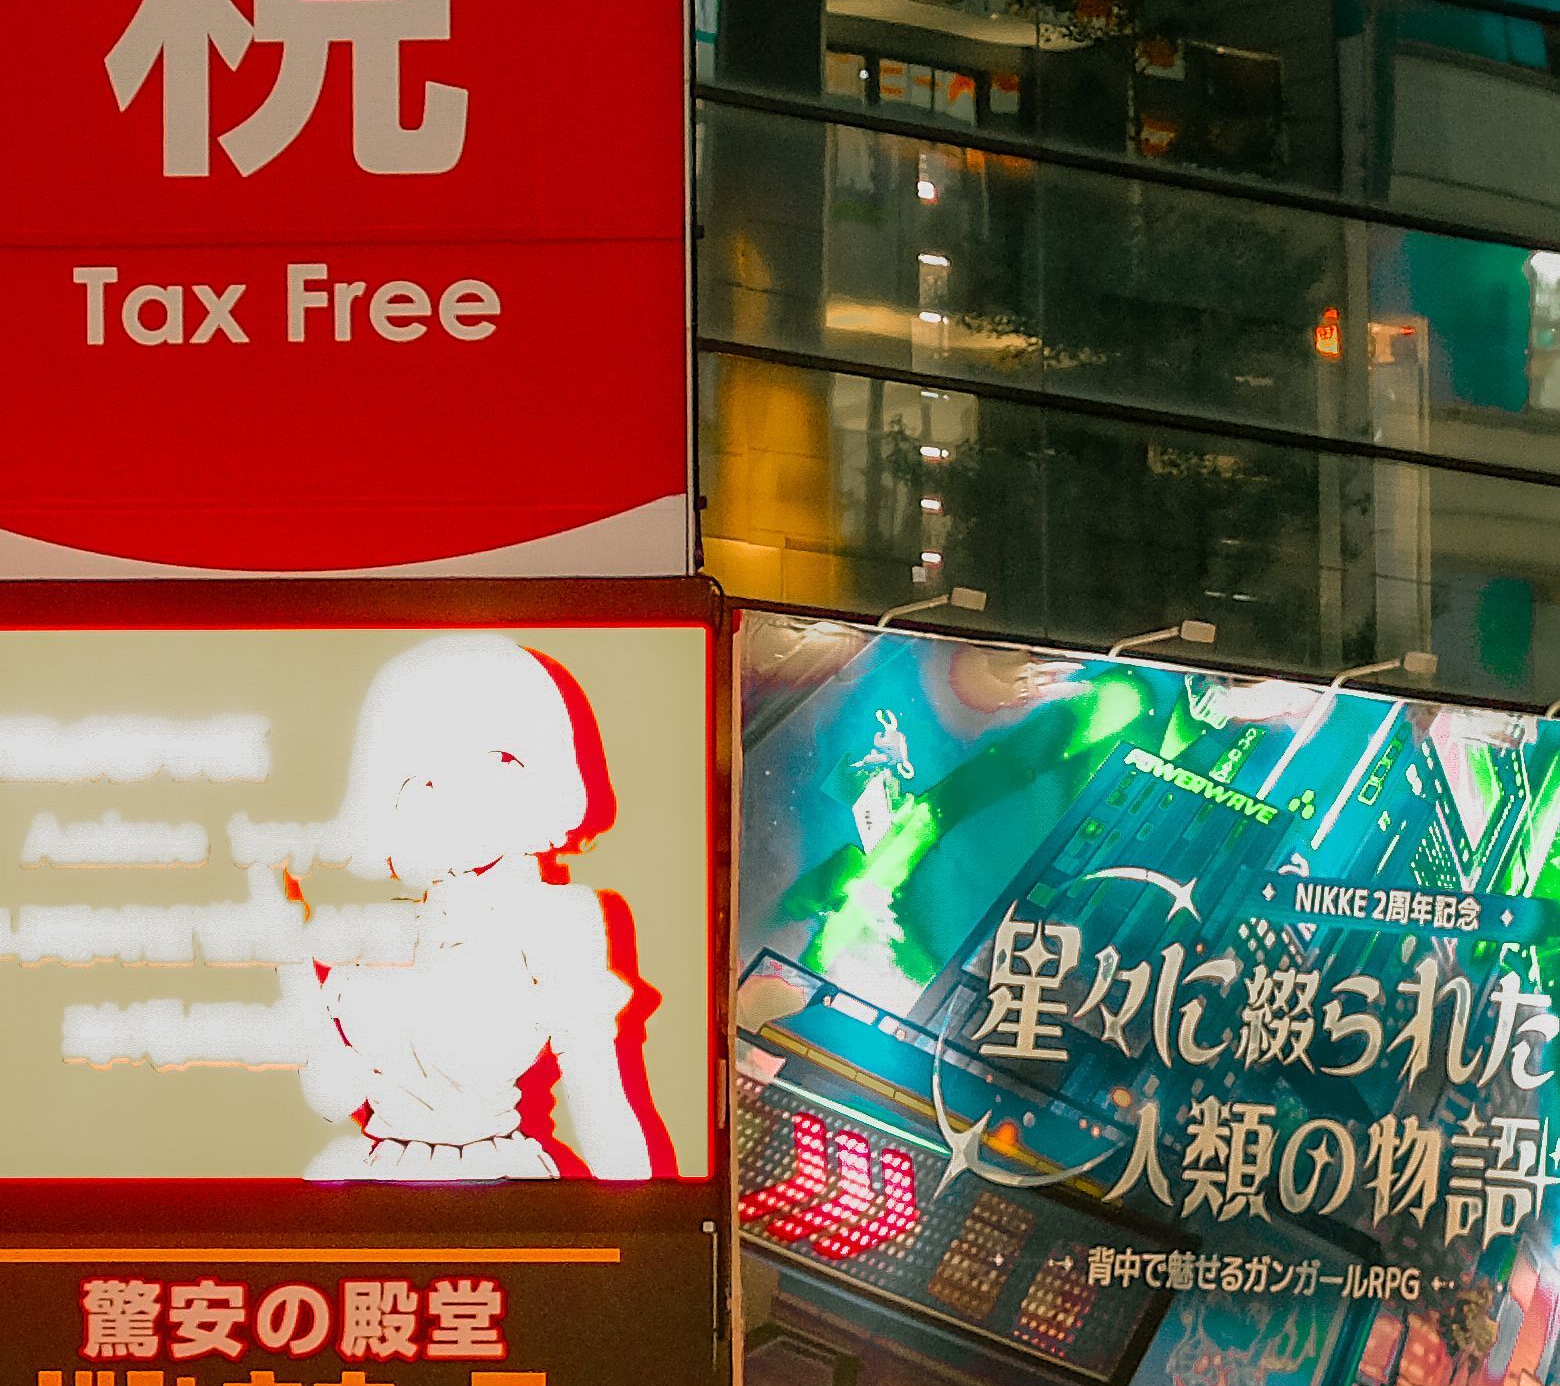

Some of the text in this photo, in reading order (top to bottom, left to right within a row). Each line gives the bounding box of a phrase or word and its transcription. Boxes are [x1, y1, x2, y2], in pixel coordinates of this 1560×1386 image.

[74, 263, 501, 346] Tax Free
[1295, 882, 1482, 932] NIKKE 2周年記念
[972, 901, 1560, 1091] 星々に綴られた
[1104, 1094, 1554, 1250] 人類の物語
[1087, 1246, 1421, 1301] 背中で魅せるガンガールRPG
[81, 1278, 508, 1360] 驚安の殿堂
